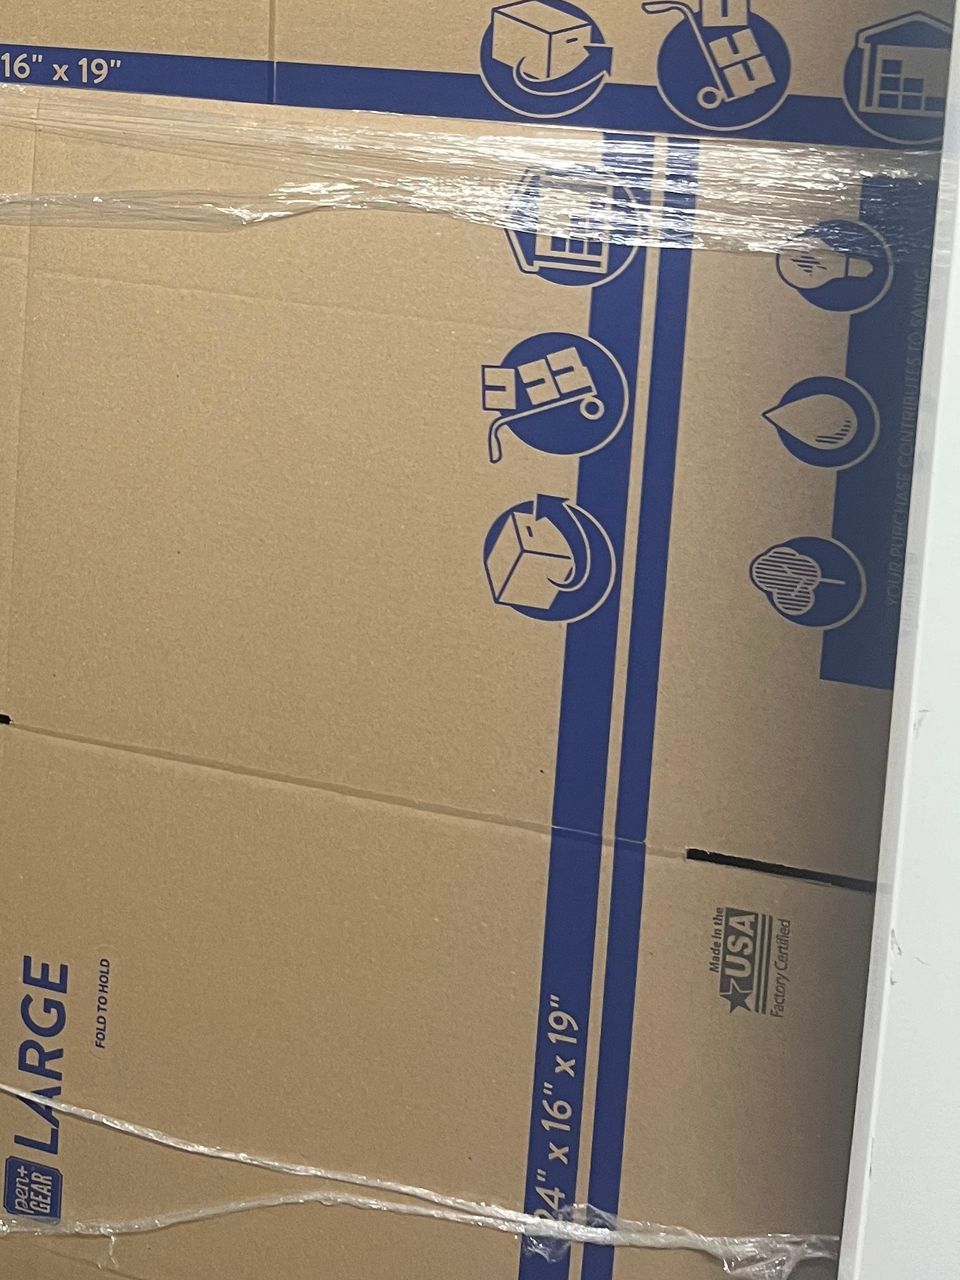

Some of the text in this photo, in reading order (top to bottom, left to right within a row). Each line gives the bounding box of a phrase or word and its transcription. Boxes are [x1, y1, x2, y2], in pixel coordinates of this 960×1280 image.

[0, 52, 43, 79] 16"
[52, 63, 69, 81] x
[78, 57, 121, 84] 19"
[712, 907, 724, 926] the
[709, 941, 722, 973] Made
[724, 914, 755, 978] USA
[770, 918, 791, 1018] Factory Certified
[95, 958, 110, 1049] FOLD TO HOLD
[547, 993, 579, 1044] 19"
[14, 955, 68, 1155] LARGE
[554, 1054, 576, 1077] x
[541, 1081, 573, 1132] 16"
[548, 1142, 569, 1165] x
[30, 1172, 52, 1213] GEAR
